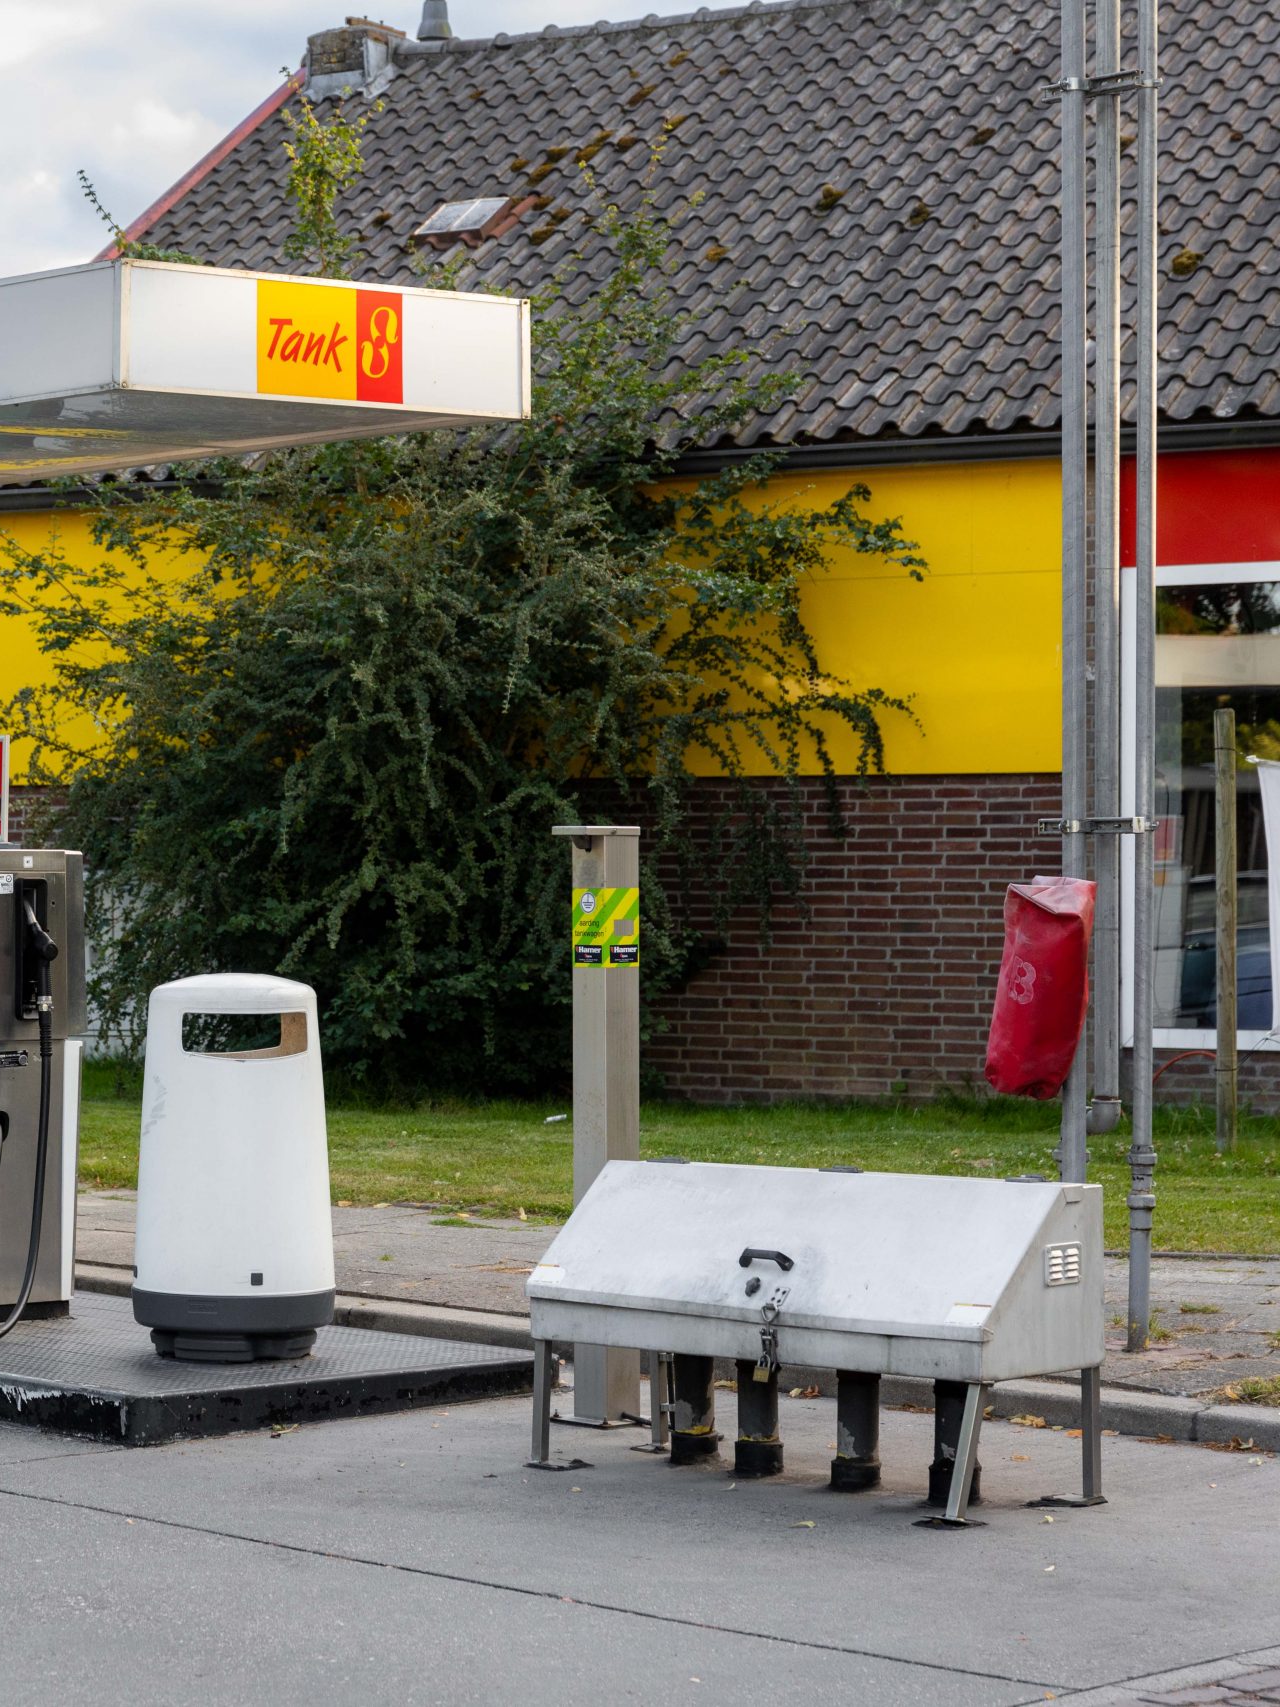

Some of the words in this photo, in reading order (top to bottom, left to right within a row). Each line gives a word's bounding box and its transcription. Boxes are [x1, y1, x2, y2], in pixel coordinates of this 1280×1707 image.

[267, 317, 348, 373] Tank
[579, 920, 600, 928] aarding
[575, 930, 604, 938] tankwagen
